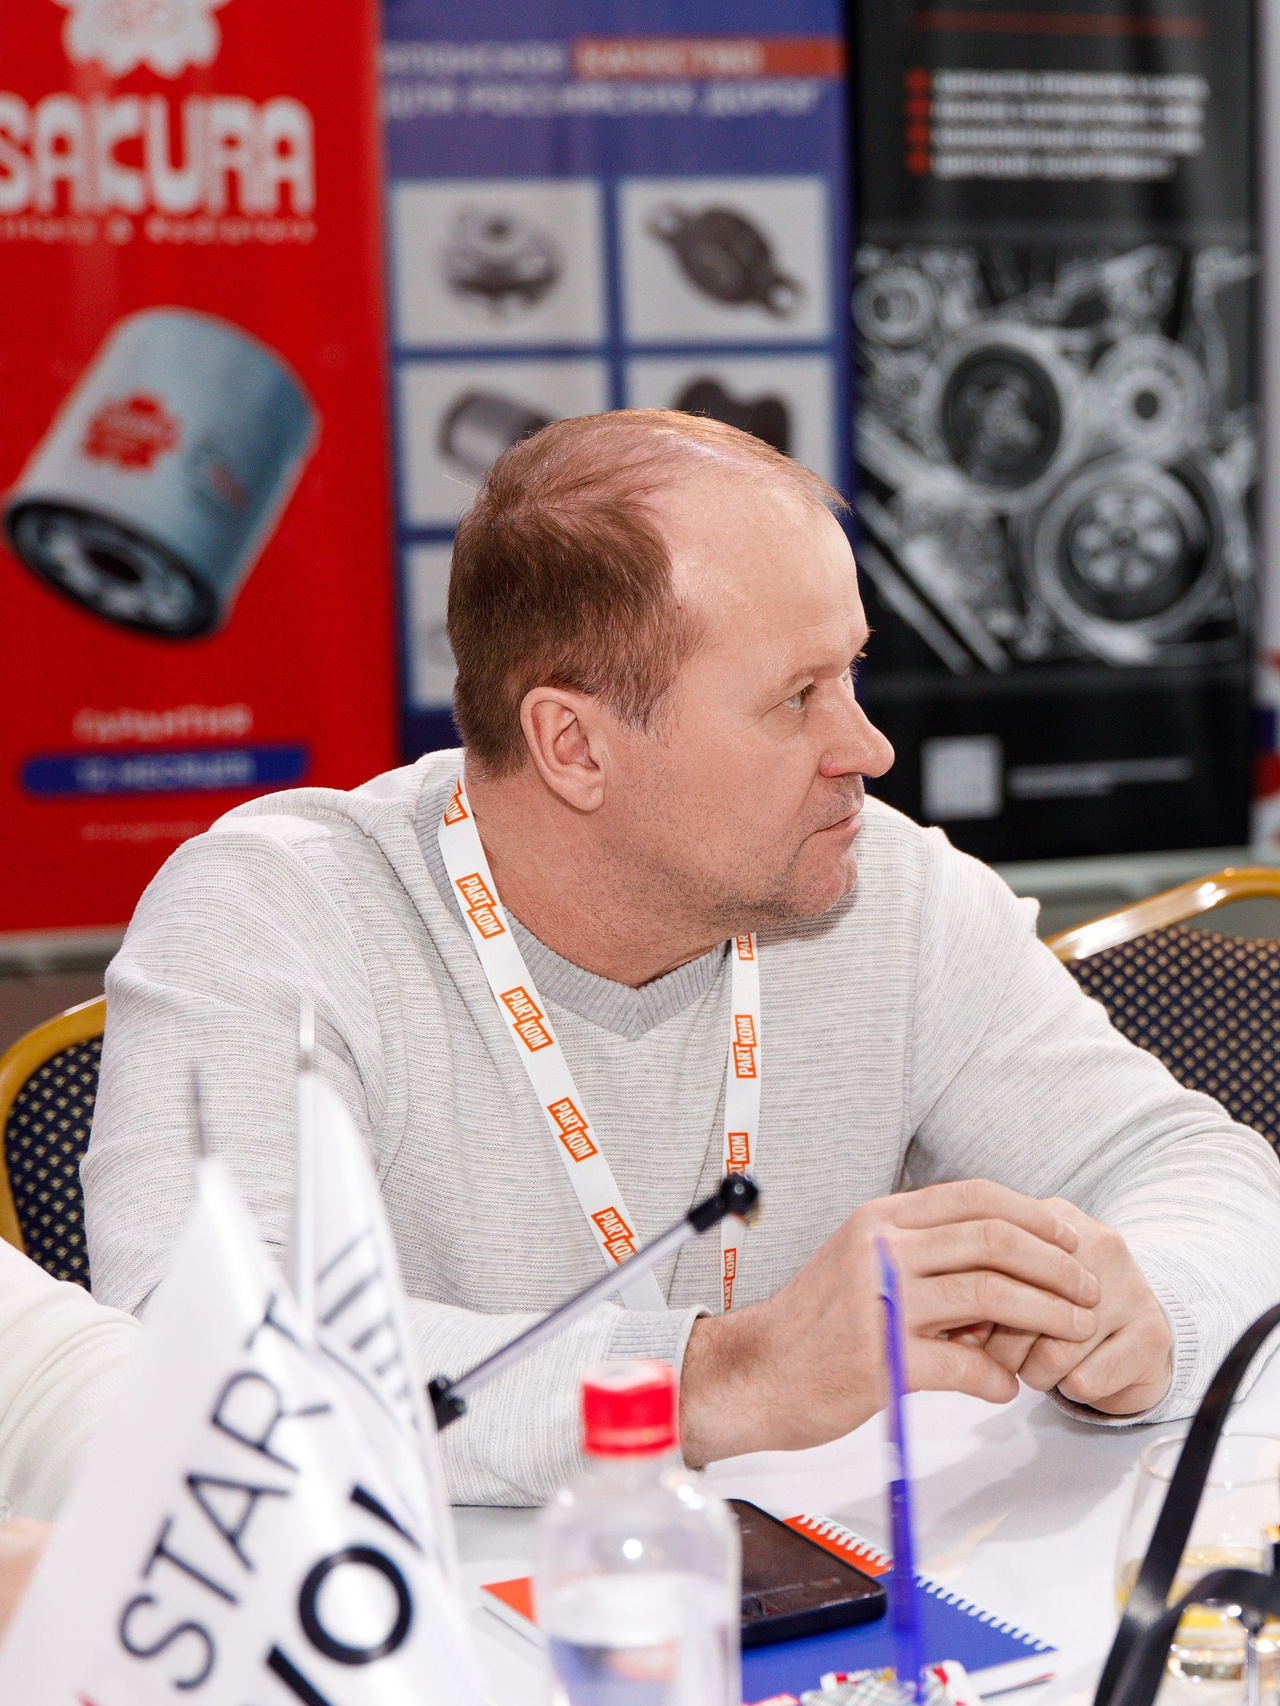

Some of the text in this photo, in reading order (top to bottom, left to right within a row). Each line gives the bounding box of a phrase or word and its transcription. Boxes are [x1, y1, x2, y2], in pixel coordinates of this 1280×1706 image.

[0, 92, 316, 214] SAKURA
[460, 876, 501, 936] PART KOM
[504, 989, 549, 1049] PART KOM
[736, 1017, 754, 1076] PART KOM
[551, 1100, 594, 1159] PART KOM
[731, 1135, 747, 1161] KOM
[595, 1210, 630, 1240] PART
[116, 1293, 333, 1693] START
